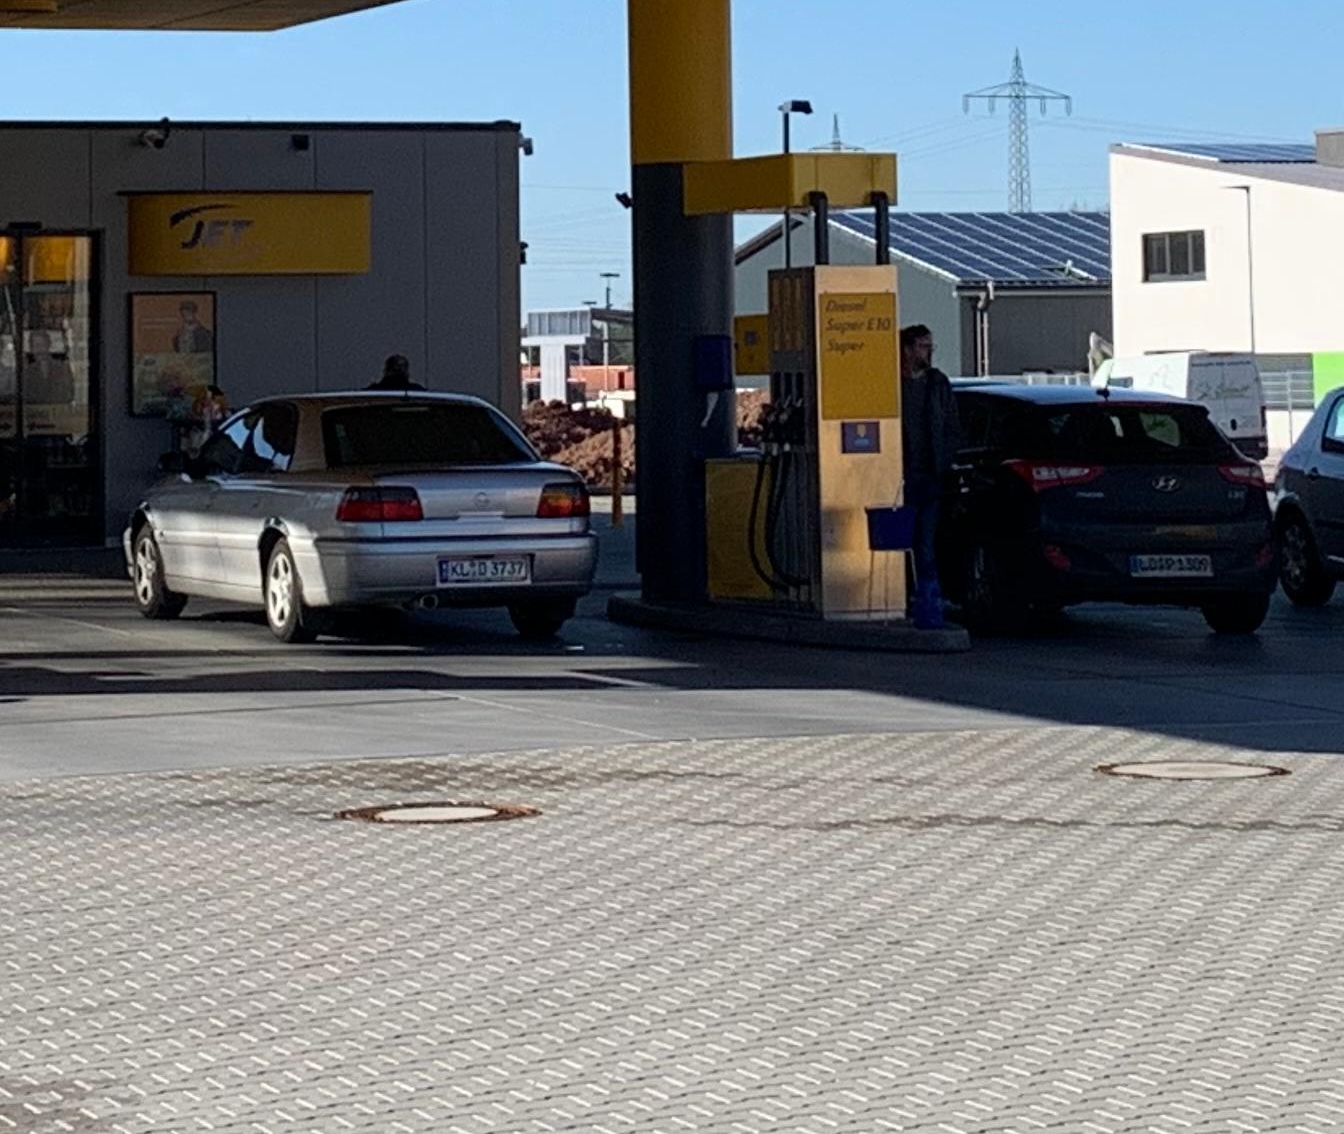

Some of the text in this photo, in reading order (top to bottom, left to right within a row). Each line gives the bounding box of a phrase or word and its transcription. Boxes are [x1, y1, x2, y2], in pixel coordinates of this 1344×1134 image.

[181, 219, 255, 249] JET
[825, 318, 865, 334] Super
[825, 338, 865, 356] Super
